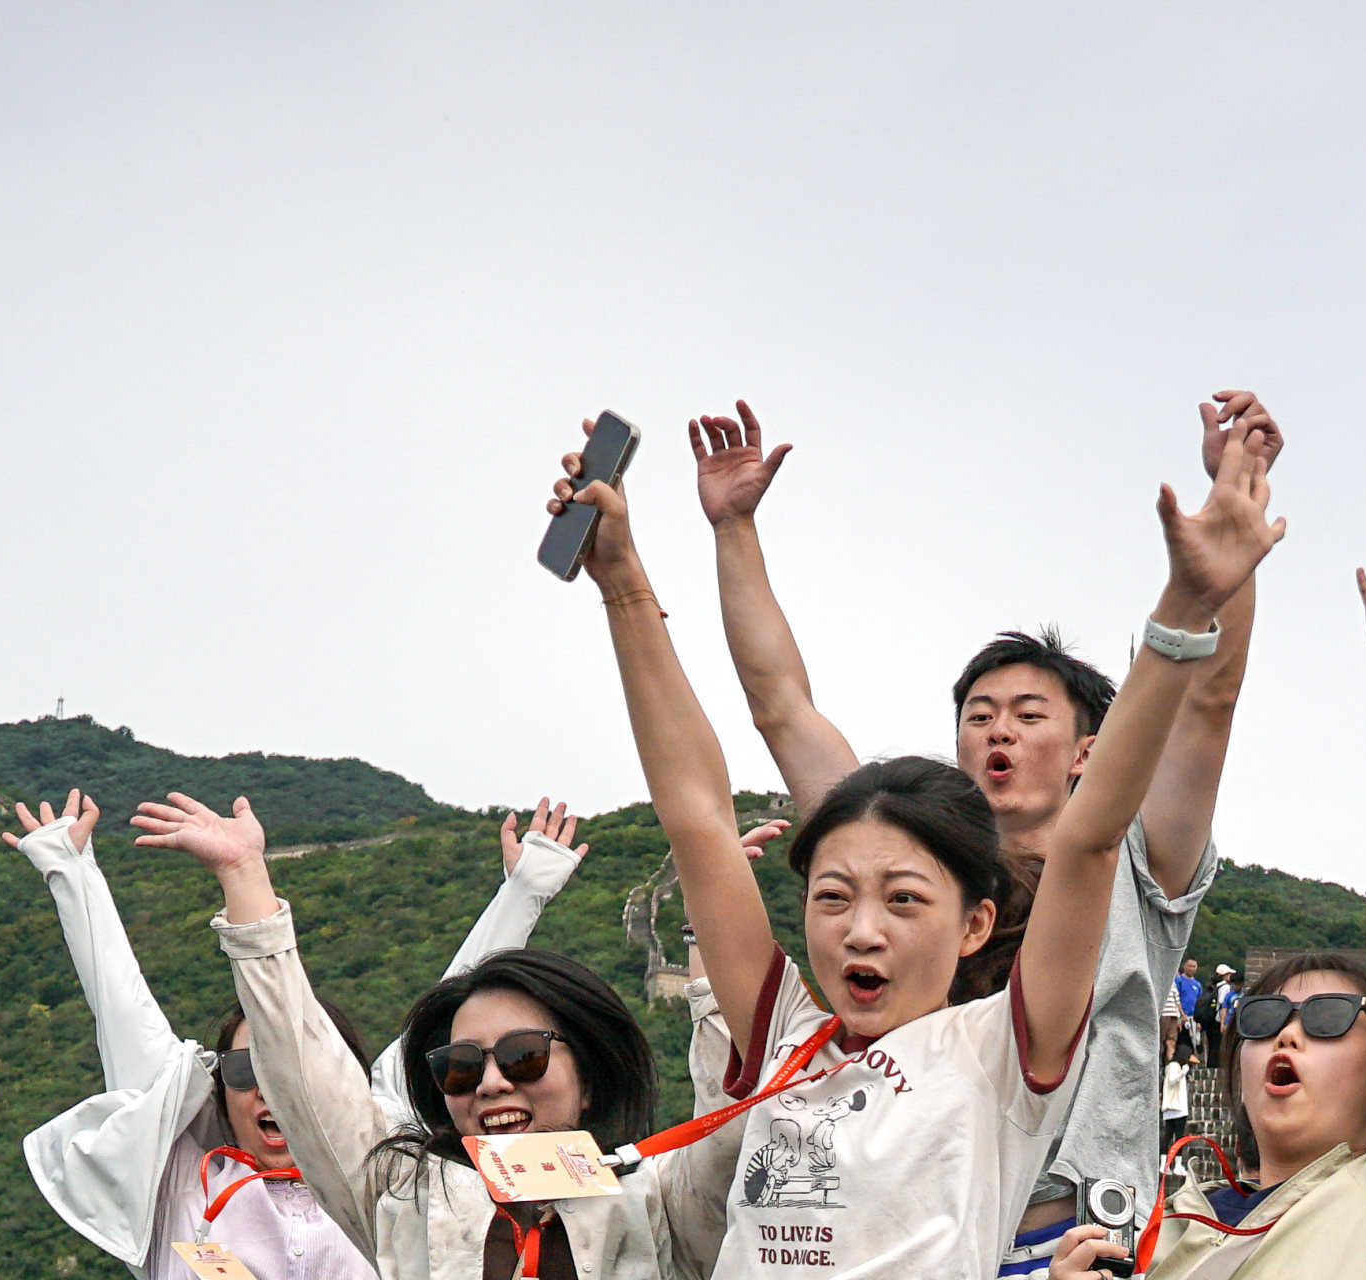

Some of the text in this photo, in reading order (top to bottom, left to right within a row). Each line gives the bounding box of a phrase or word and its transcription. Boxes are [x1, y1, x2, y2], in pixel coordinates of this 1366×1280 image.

[758, 1224, 834, 1243] TO LIVE IS
[758, 1247, 835, 1266] TO DANCE.
